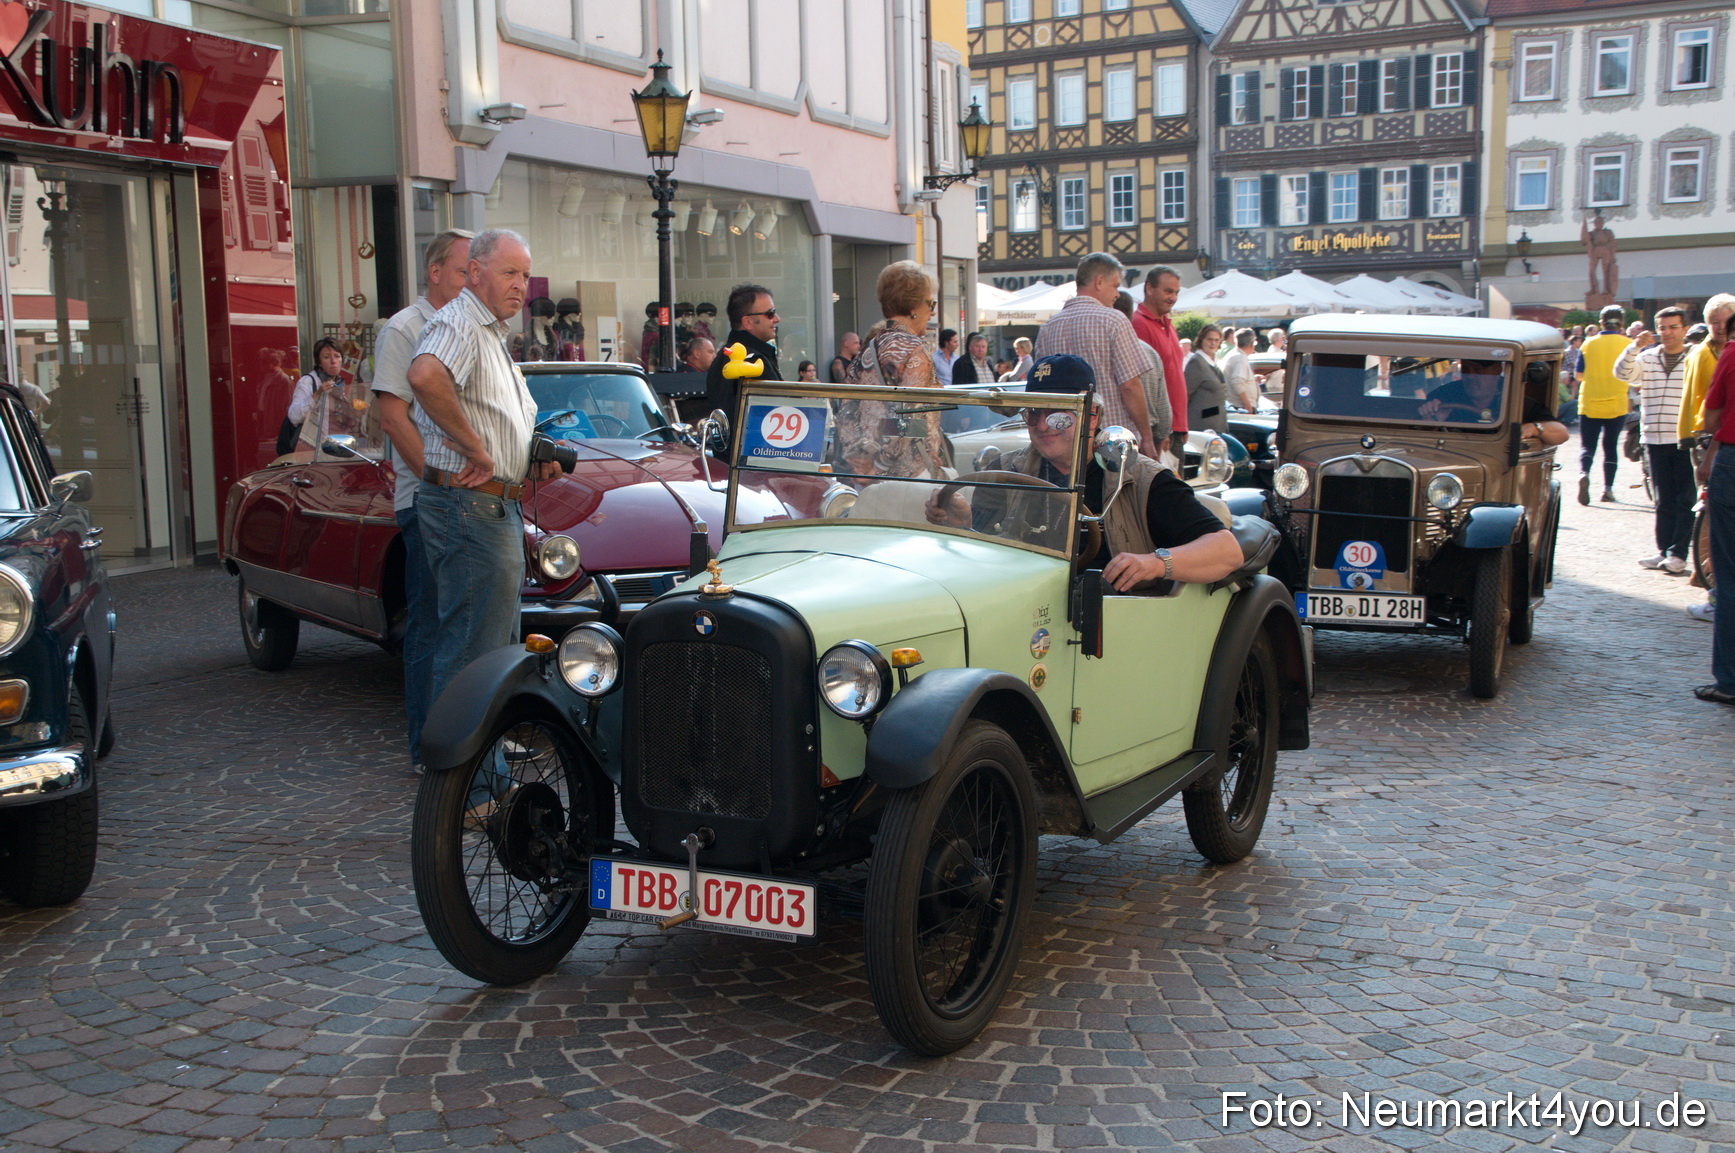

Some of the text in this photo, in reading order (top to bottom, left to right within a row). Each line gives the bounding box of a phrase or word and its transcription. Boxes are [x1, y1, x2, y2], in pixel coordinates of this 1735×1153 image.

[0, 9, 184, 144] Kuhn
[1294, 232, 1391, 254] Engel Apotheke
[1426, 232, 1462, 240] Restaurant
[766, 412, 802, 442] 29
[753, 447, 814, 458] Oldtimerkorso
[1348, 545, 1372, 563] 30
[1309, 596, 1422, 619] TBB DI 28H
[598, 889, 605, 899] D
[617, 867, 805, 928] TBB 07003
[628, 913, 639, 921] TOP
[641, 915, 653, 923] CAR
